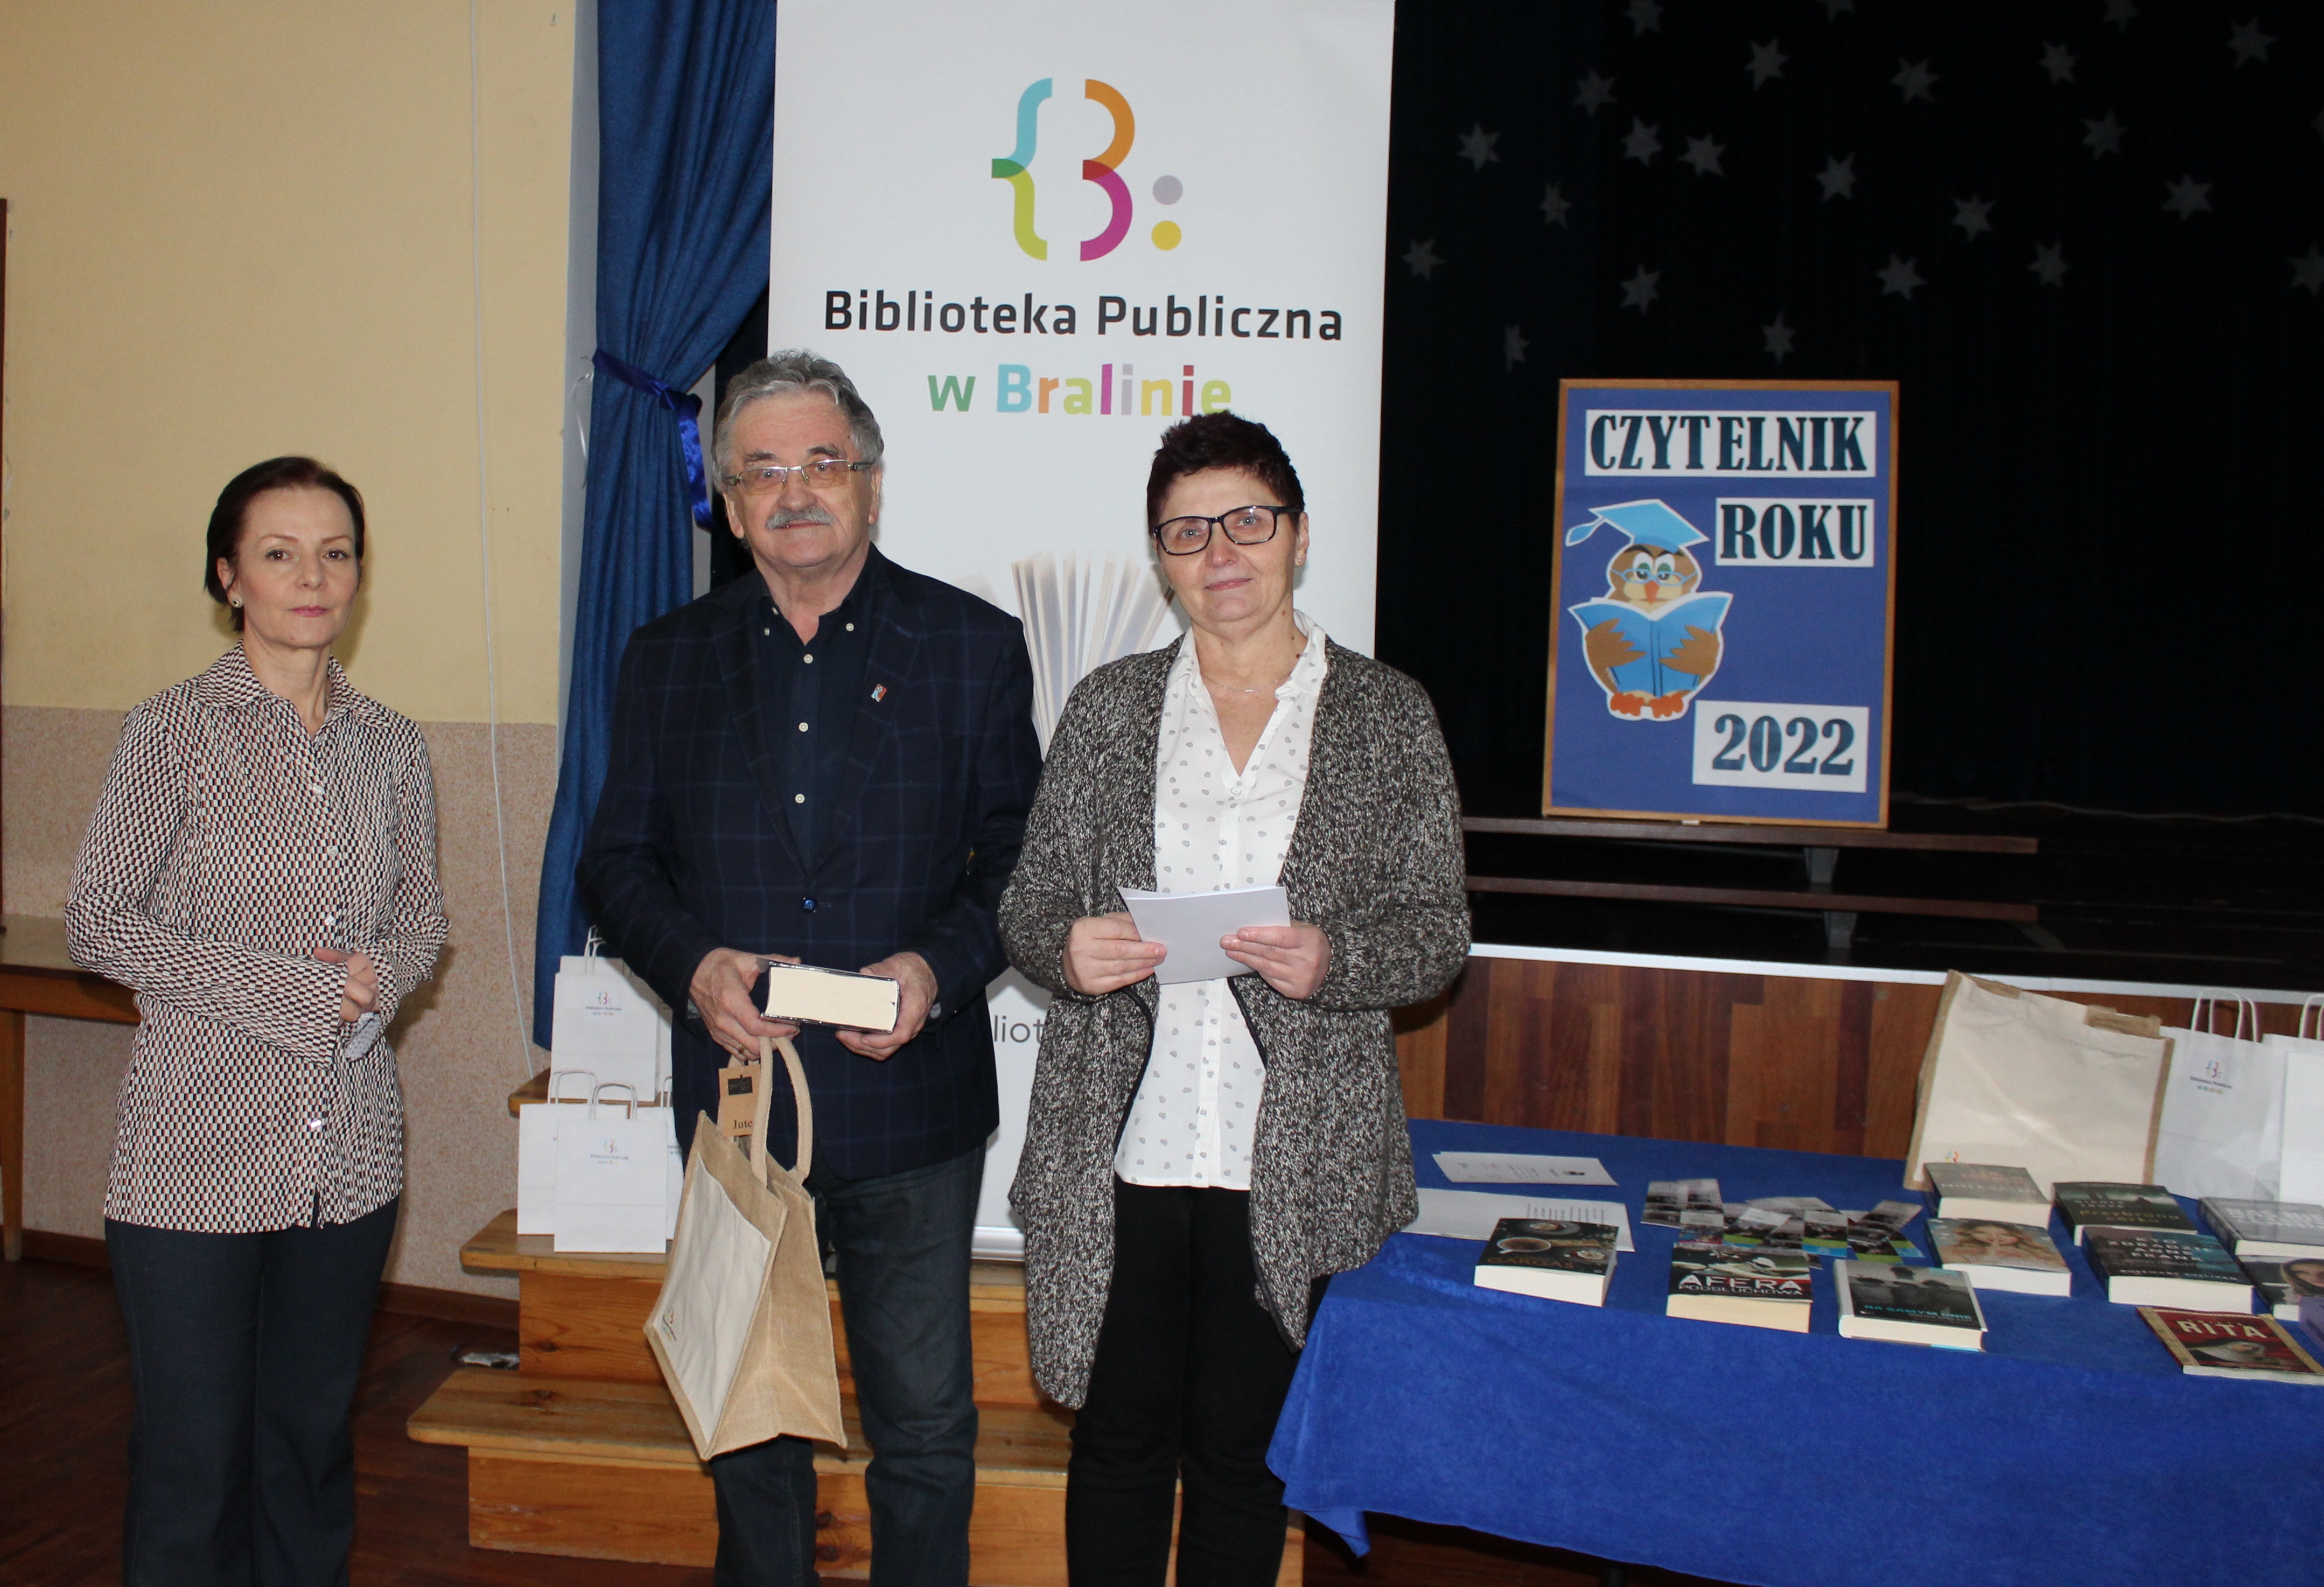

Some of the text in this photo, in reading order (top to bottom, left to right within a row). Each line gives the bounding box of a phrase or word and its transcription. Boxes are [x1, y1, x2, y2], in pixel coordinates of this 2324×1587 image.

[825, 289, 1342, 340] Biblioteka Publiczna
[927, 363, 1232, 417] w Bralinie
[1590, 415, 1866, 472] CZYTELNIK
[1720, 504, 1867, 560] ROKU
[1712, 714, 1854, 775] 2022
[733, 1120, 753, 1129] Jute
[1679, 1274, 1803, 1291] AFERA
[1886, 1306, 1938, 1316] SAMYM
[2176, 1320, 2267, 1339] RITA
